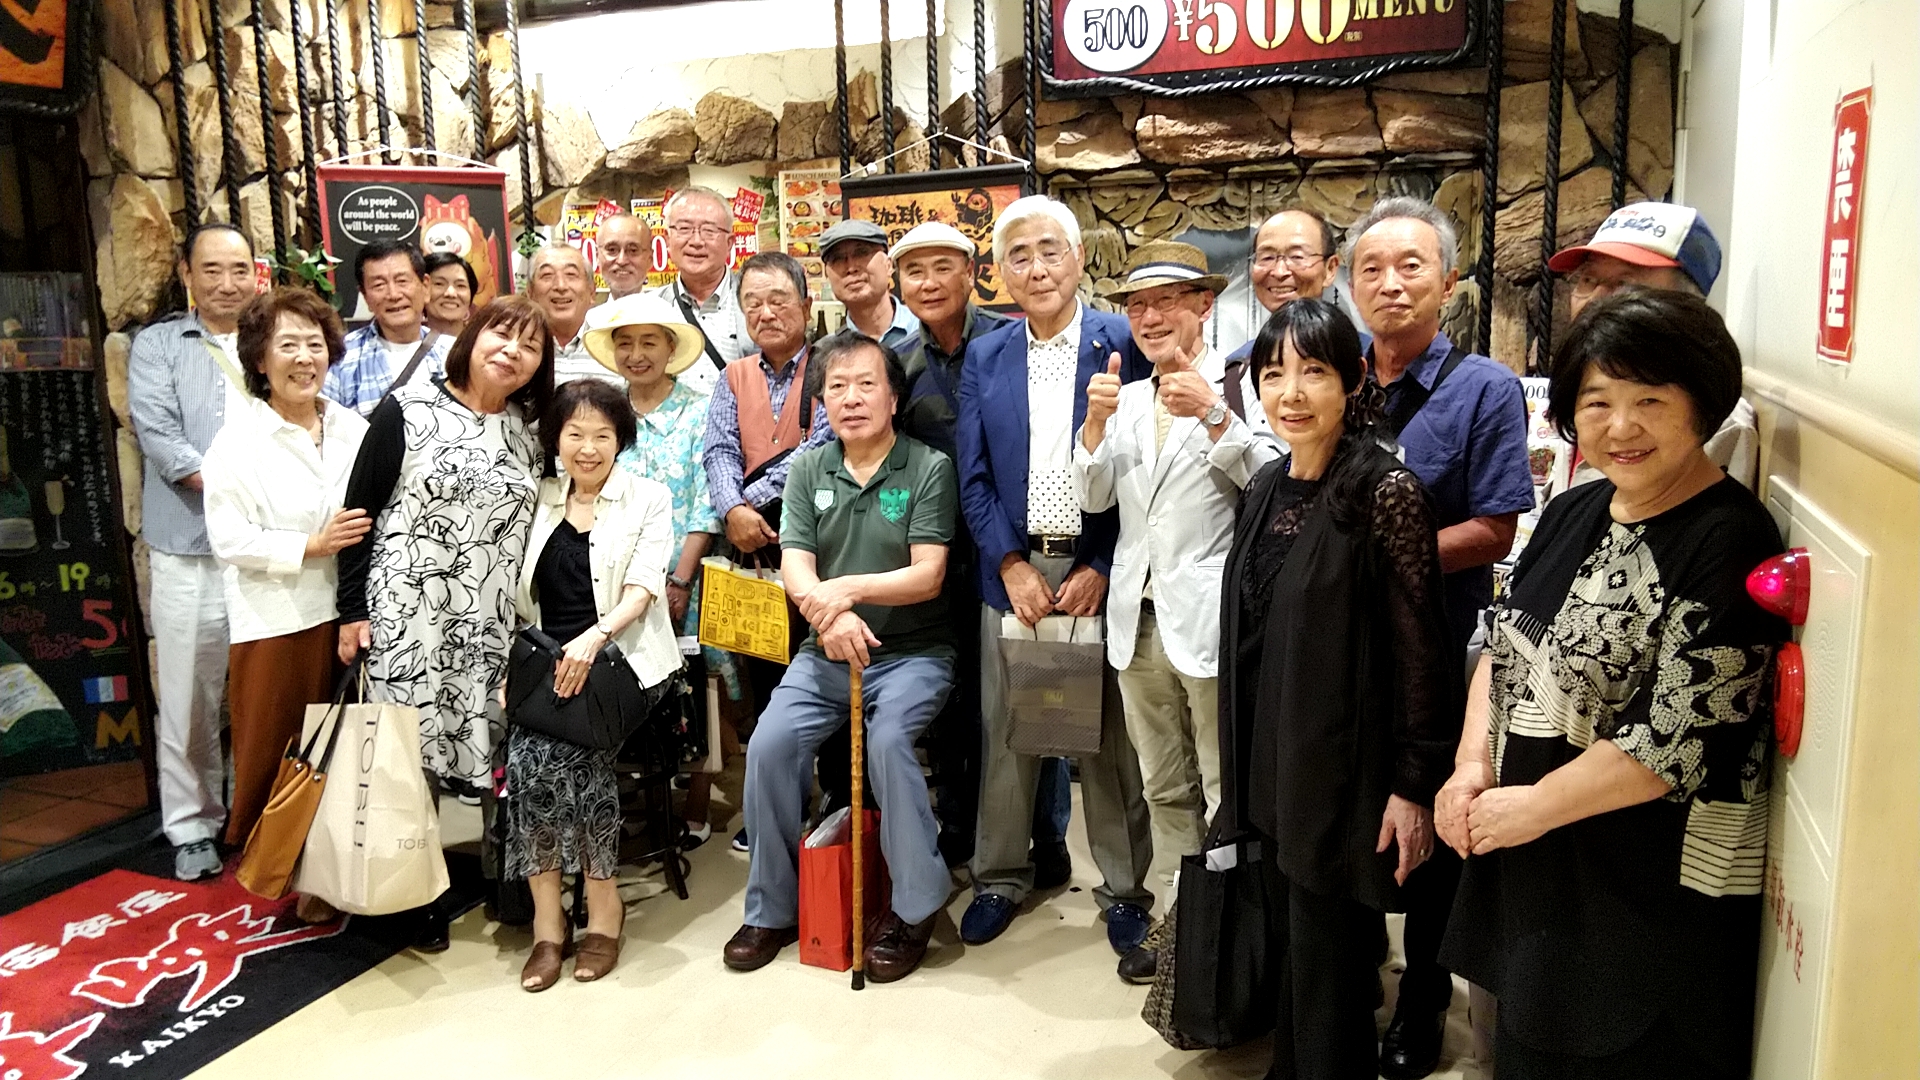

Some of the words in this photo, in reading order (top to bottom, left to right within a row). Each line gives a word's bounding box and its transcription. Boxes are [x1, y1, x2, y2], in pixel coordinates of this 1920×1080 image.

[1353, 0, 1454, 20] MENU
[1084, 5, 1149, 52] 500
[357, 196, 369, 206] As
[370, 195, 398, 208] people
[344, 209, 375, 219] around
[376, 209, 390, 219] the
[390, 209, 415, 219] world
[869, 200, 924, 226] 珈琲
[345, 221, 362, 231] will
[362, 221, 374, 231] be
[374, 223, 401, 234] peace.
[735, 235, 757, 253] 半額
[396, 838, 427, 851] TOB
[109, 995, 245, 1068] KAIKYO
